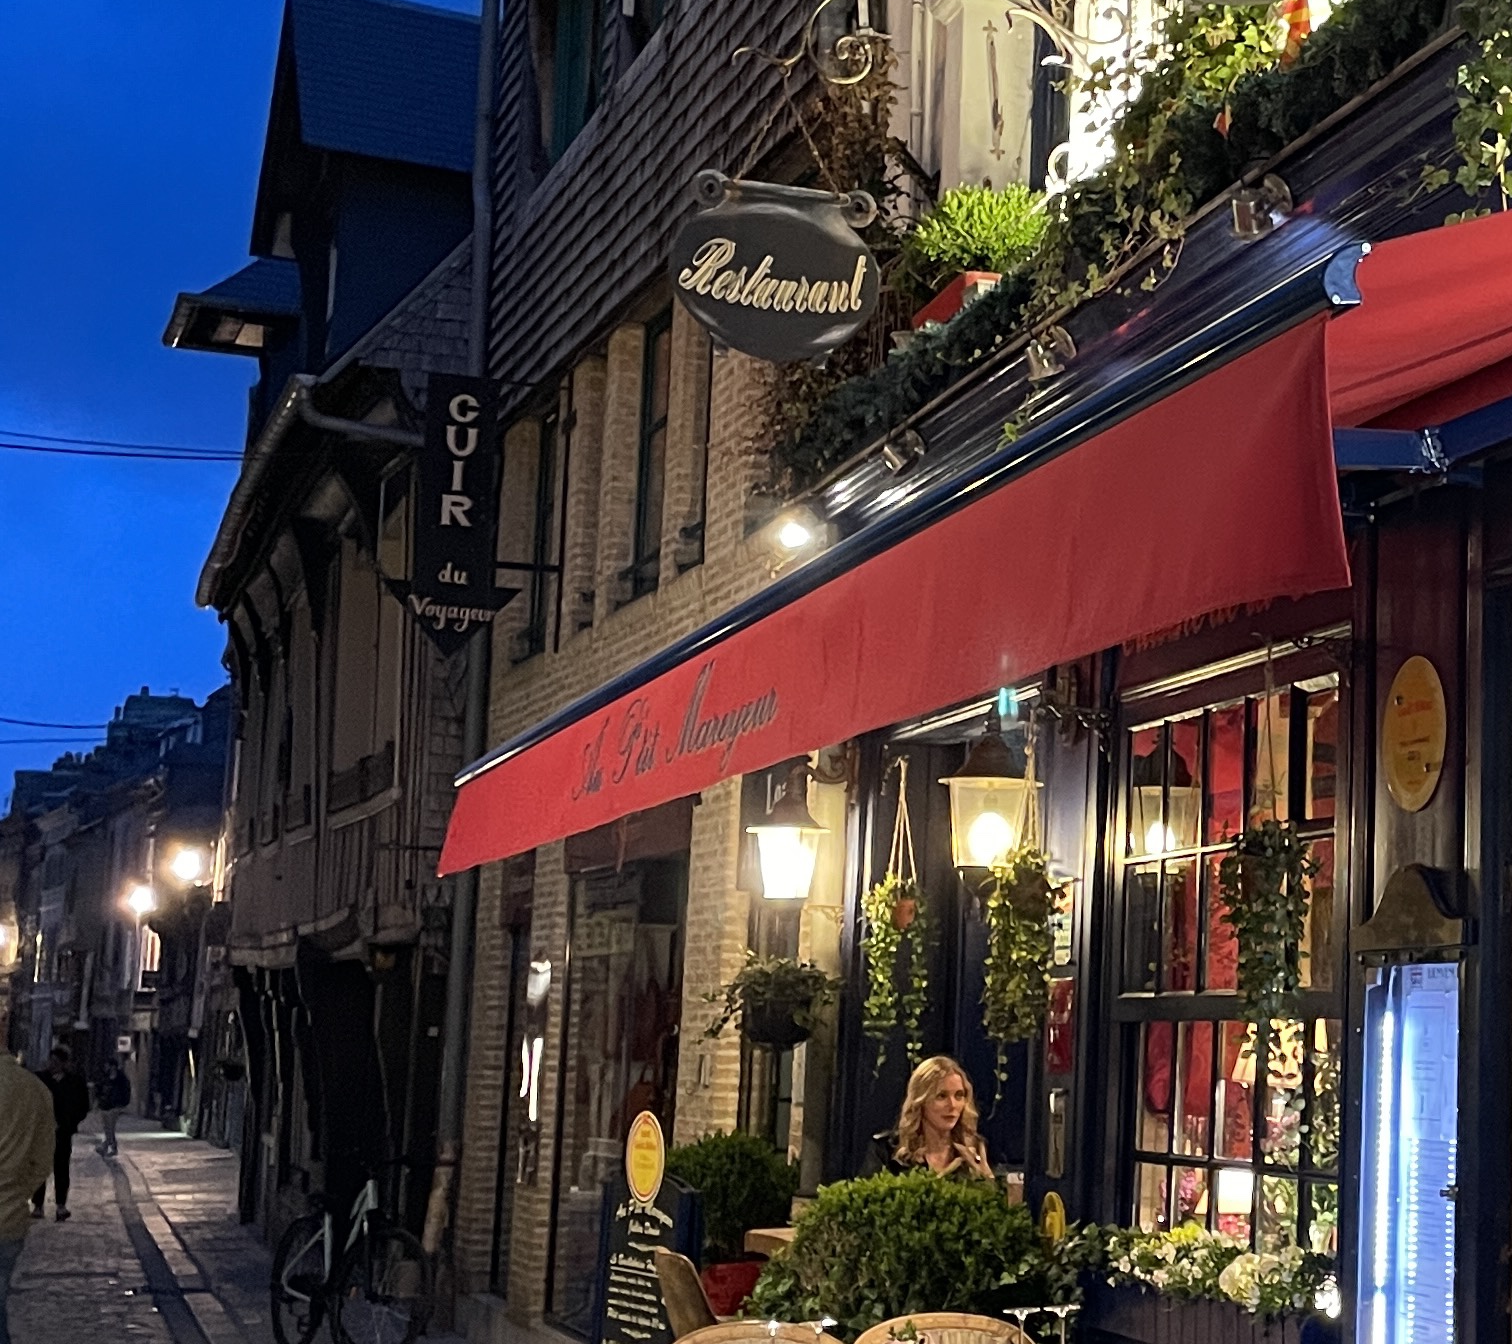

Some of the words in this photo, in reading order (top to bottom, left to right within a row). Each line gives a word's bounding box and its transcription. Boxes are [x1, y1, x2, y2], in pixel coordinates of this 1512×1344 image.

[678, 237, 867, 314] Restaurant
[440, 394, 481, 527] CUIR
[438, 562, 468, 585] du
[408, 594, 496, 632] Voyageur
